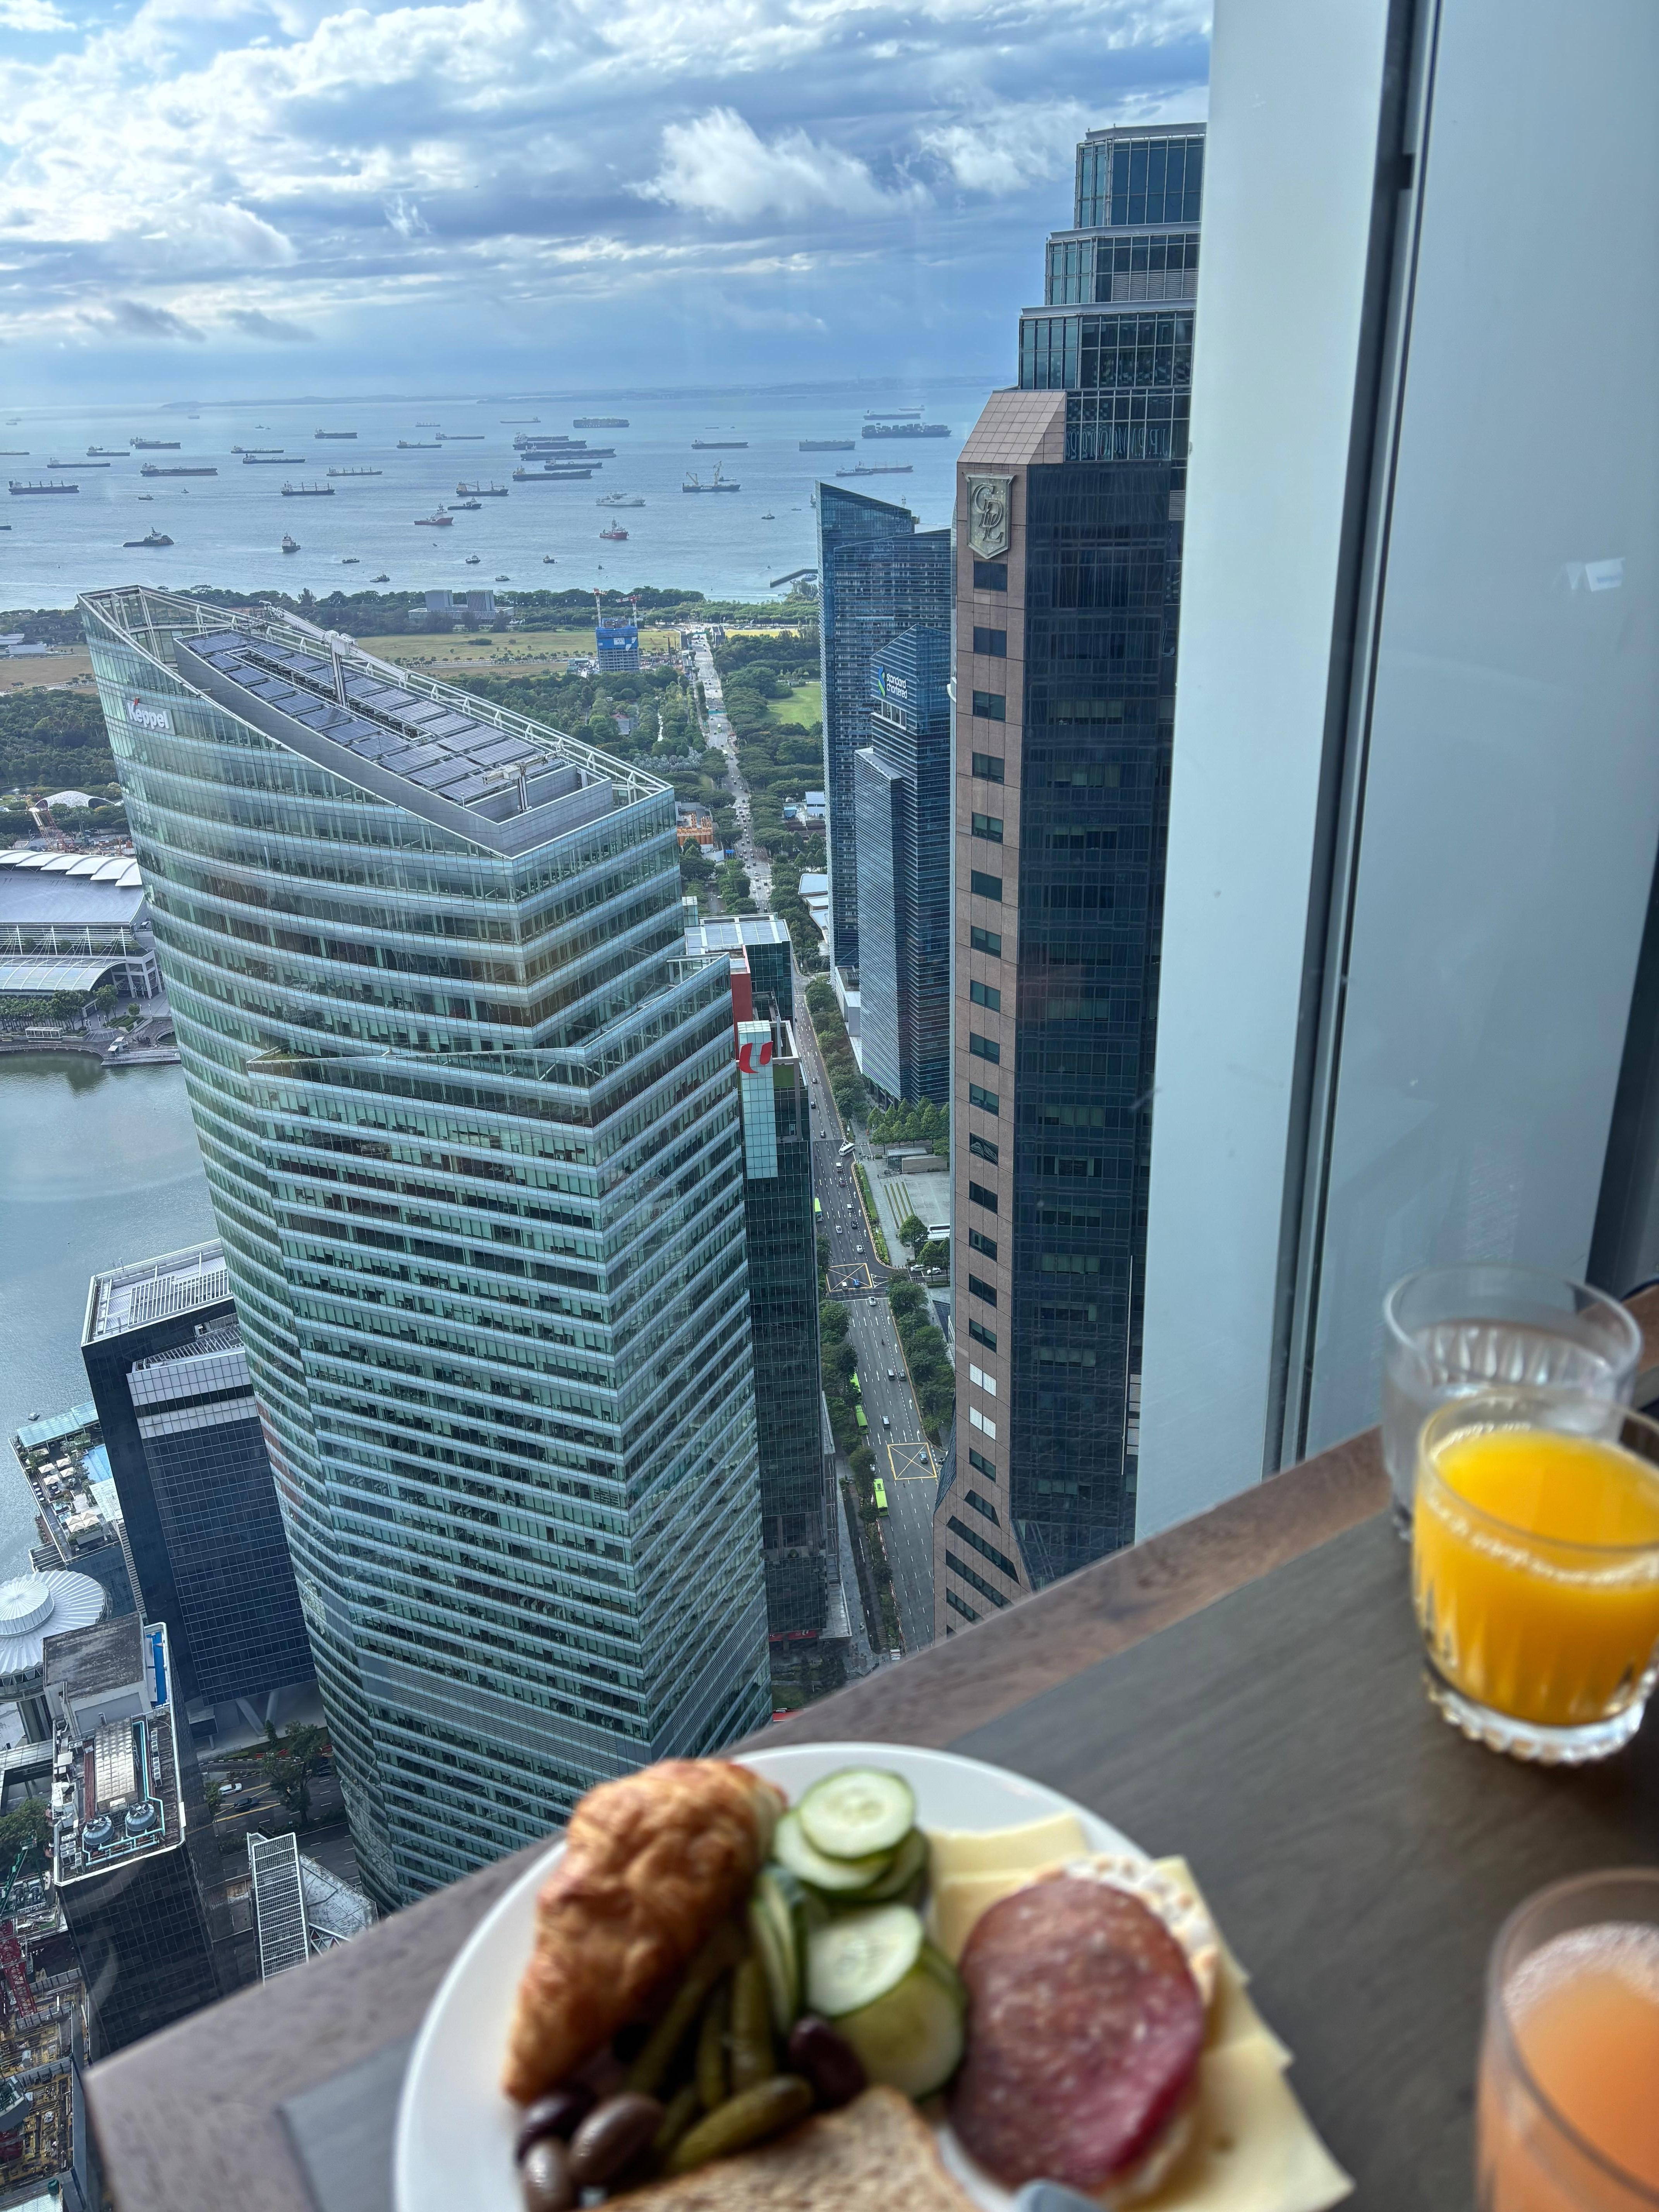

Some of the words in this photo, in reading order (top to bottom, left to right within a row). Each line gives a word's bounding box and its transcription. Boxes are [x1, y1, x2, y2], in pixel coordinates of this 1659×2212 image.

[886, 672, 906, 689] standard
[887, 682, 907, 699] chartered
[127, 698, 170, 729] Keppel
